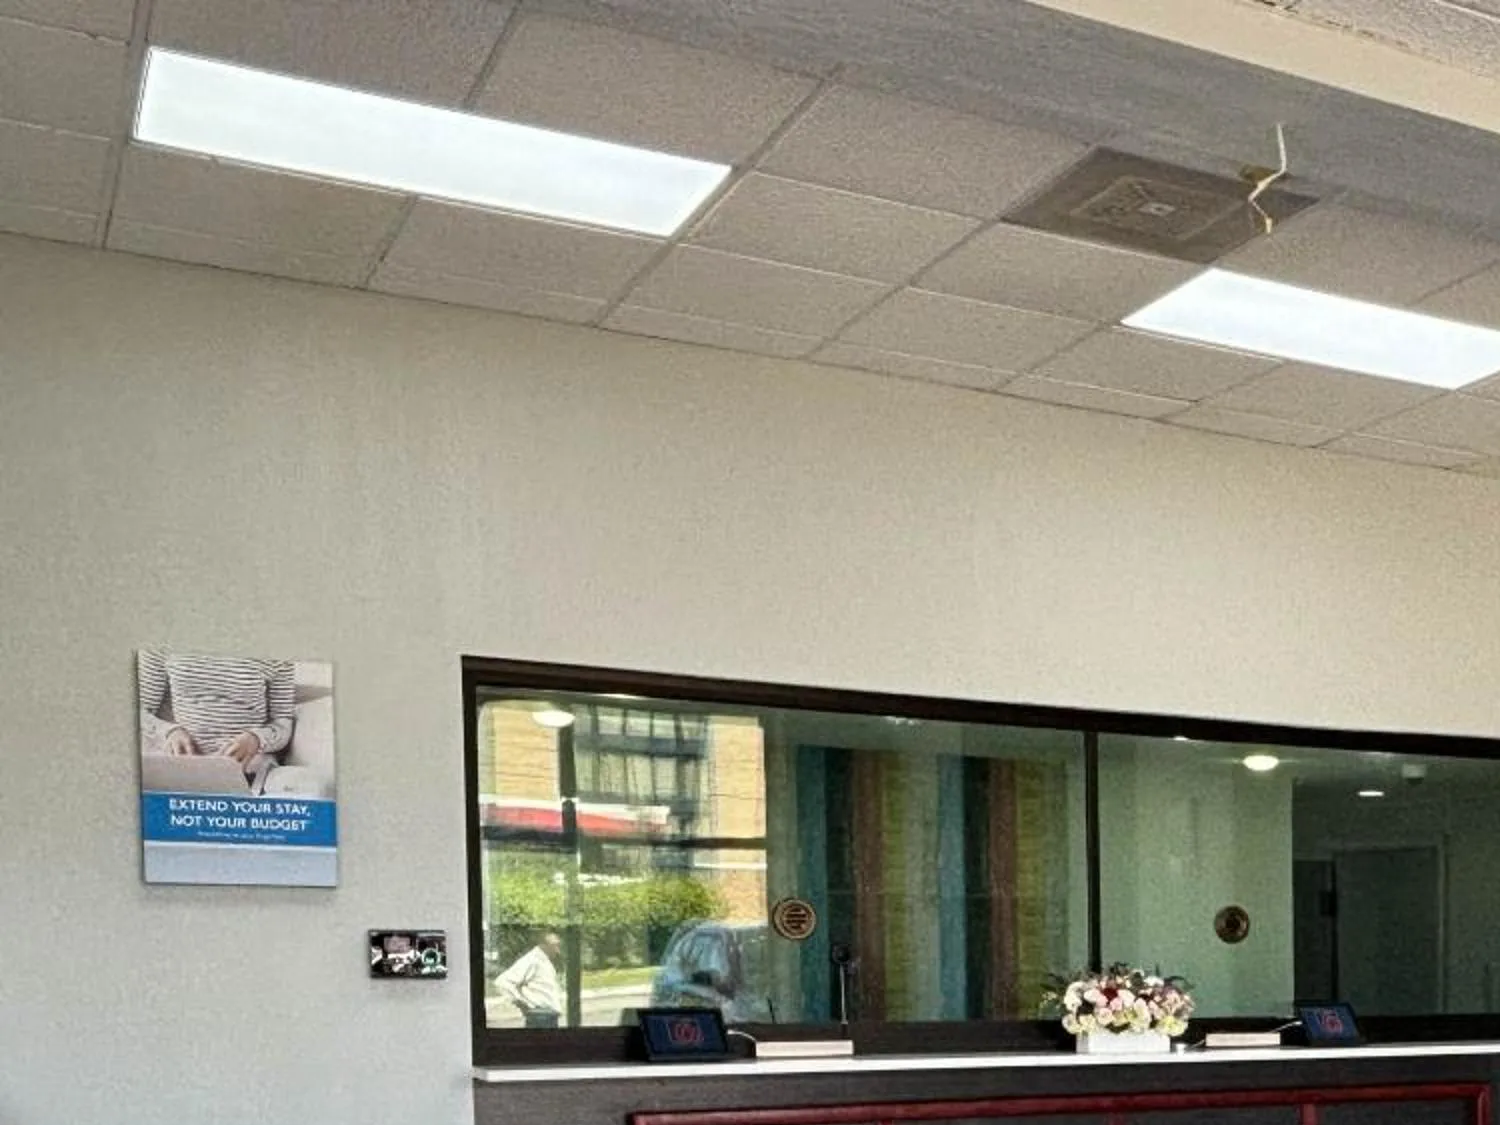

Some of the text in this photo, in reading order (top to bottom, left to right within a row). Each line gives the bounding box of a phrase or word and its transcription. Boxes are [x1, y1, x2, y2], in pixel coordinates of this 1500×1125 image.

[169, 798, 311, 817] EXTEND YOUR STAY,
[170, 815, 307, 831] NOT YOUR BUDGET
